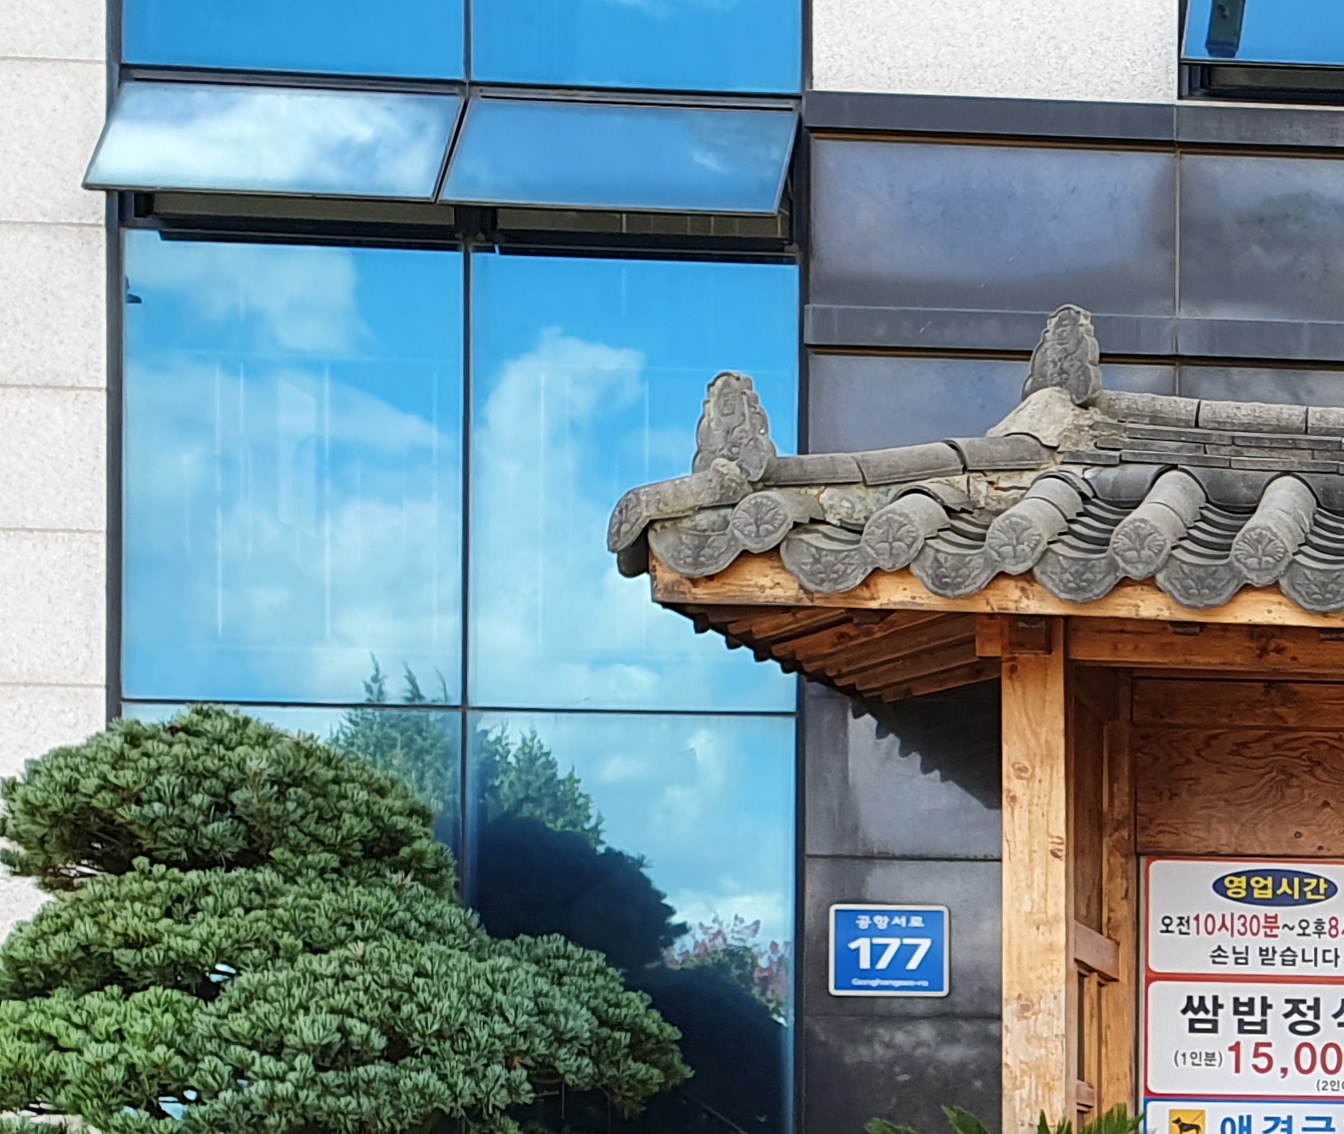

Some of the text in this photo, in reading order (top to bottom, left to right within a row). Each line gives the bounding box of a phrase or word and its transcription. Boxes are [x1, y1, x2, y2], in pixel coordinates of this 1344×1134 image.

[1224, 876, 1328, 900] 영업시간
[847, 937, 932, 970] 177
[1209, 945, 1341, 968] 손님 받습니다
[1174, 1050, 1223, 1068] (1인분)
